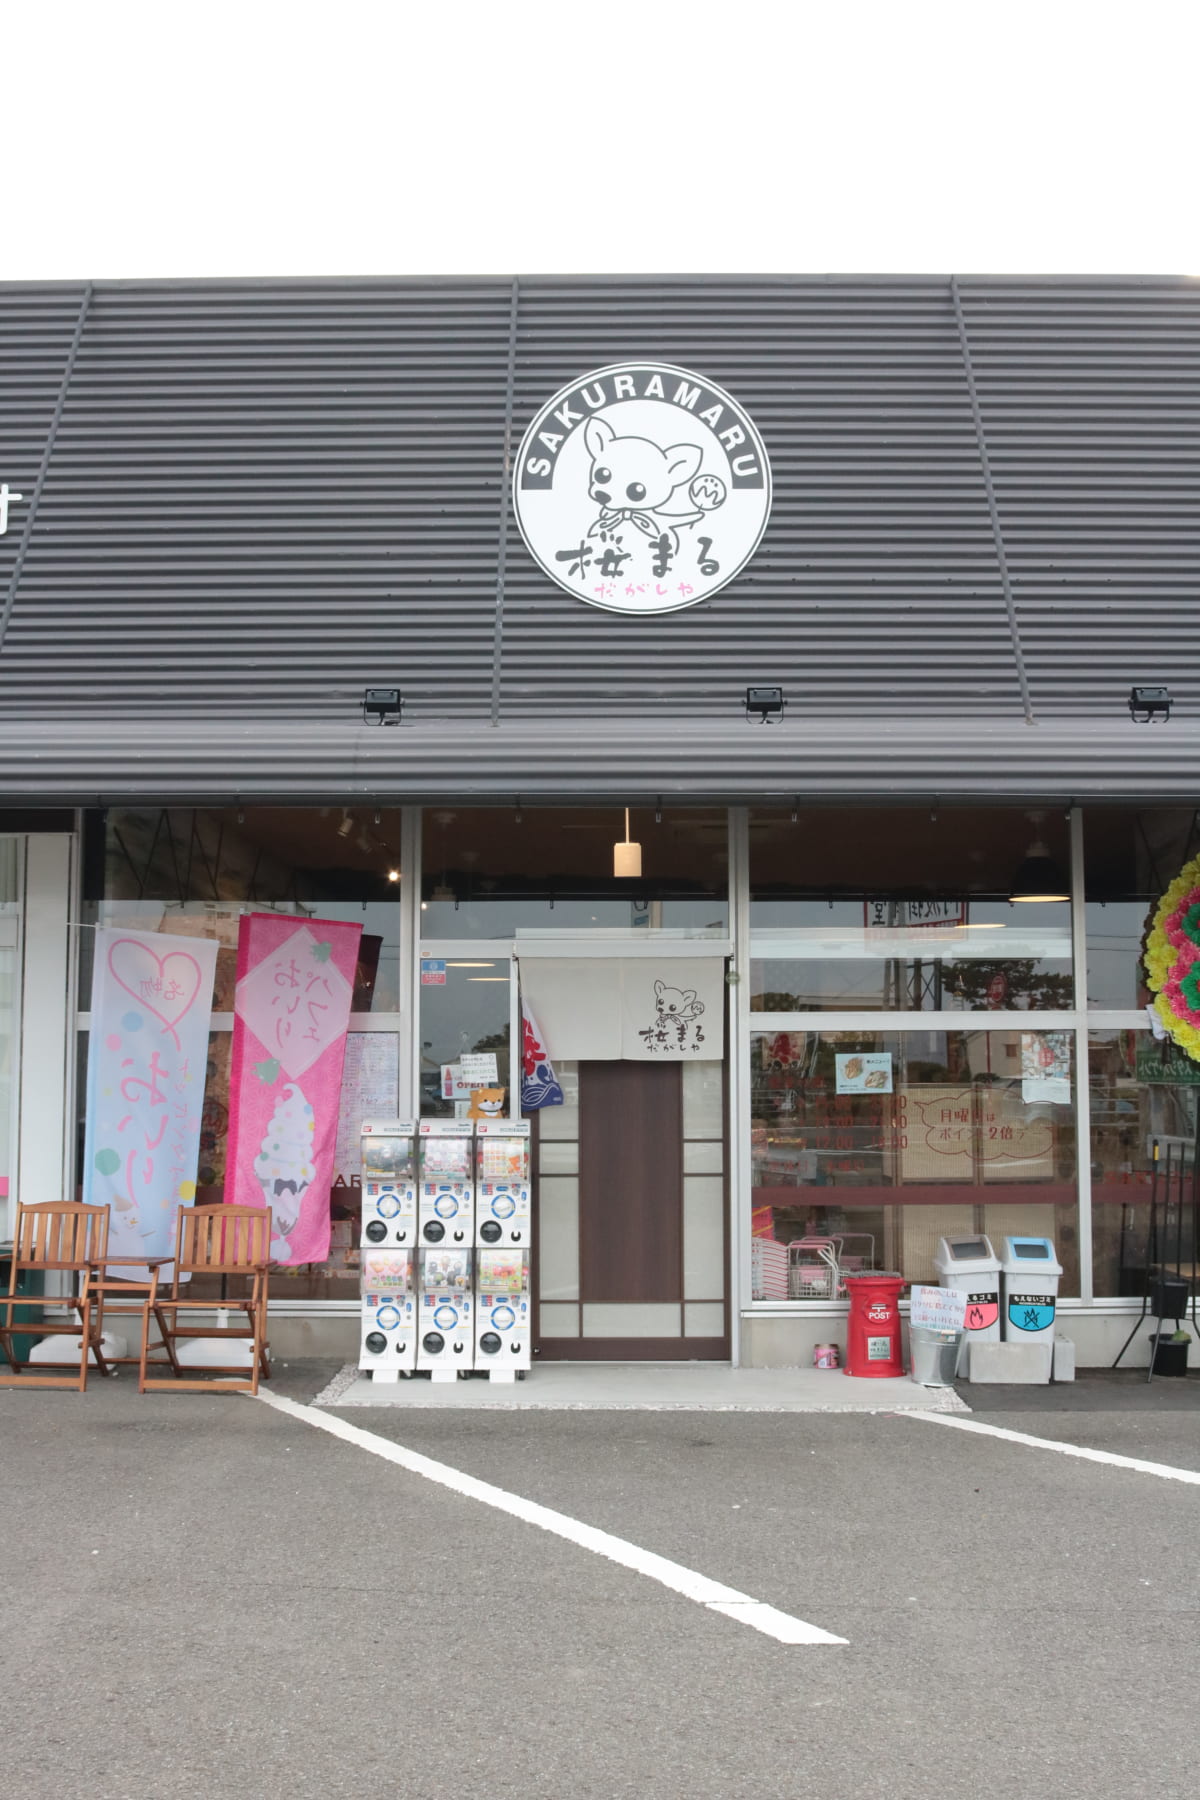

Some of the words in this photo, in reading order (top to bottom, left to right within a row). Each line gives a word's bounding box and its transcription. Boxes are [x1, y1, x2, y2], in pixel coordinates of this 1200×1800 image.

[526, 374, 759, 478] SAKURAMARU
[555, 531, 720, 580] 桜まる
[594, 582, 694, 598] だがしや
[638, 1022, 706, 1044] 桜まる
[646, 1043, 701, 1053] だがしや
[868, 1312, 890, 1320] POST
